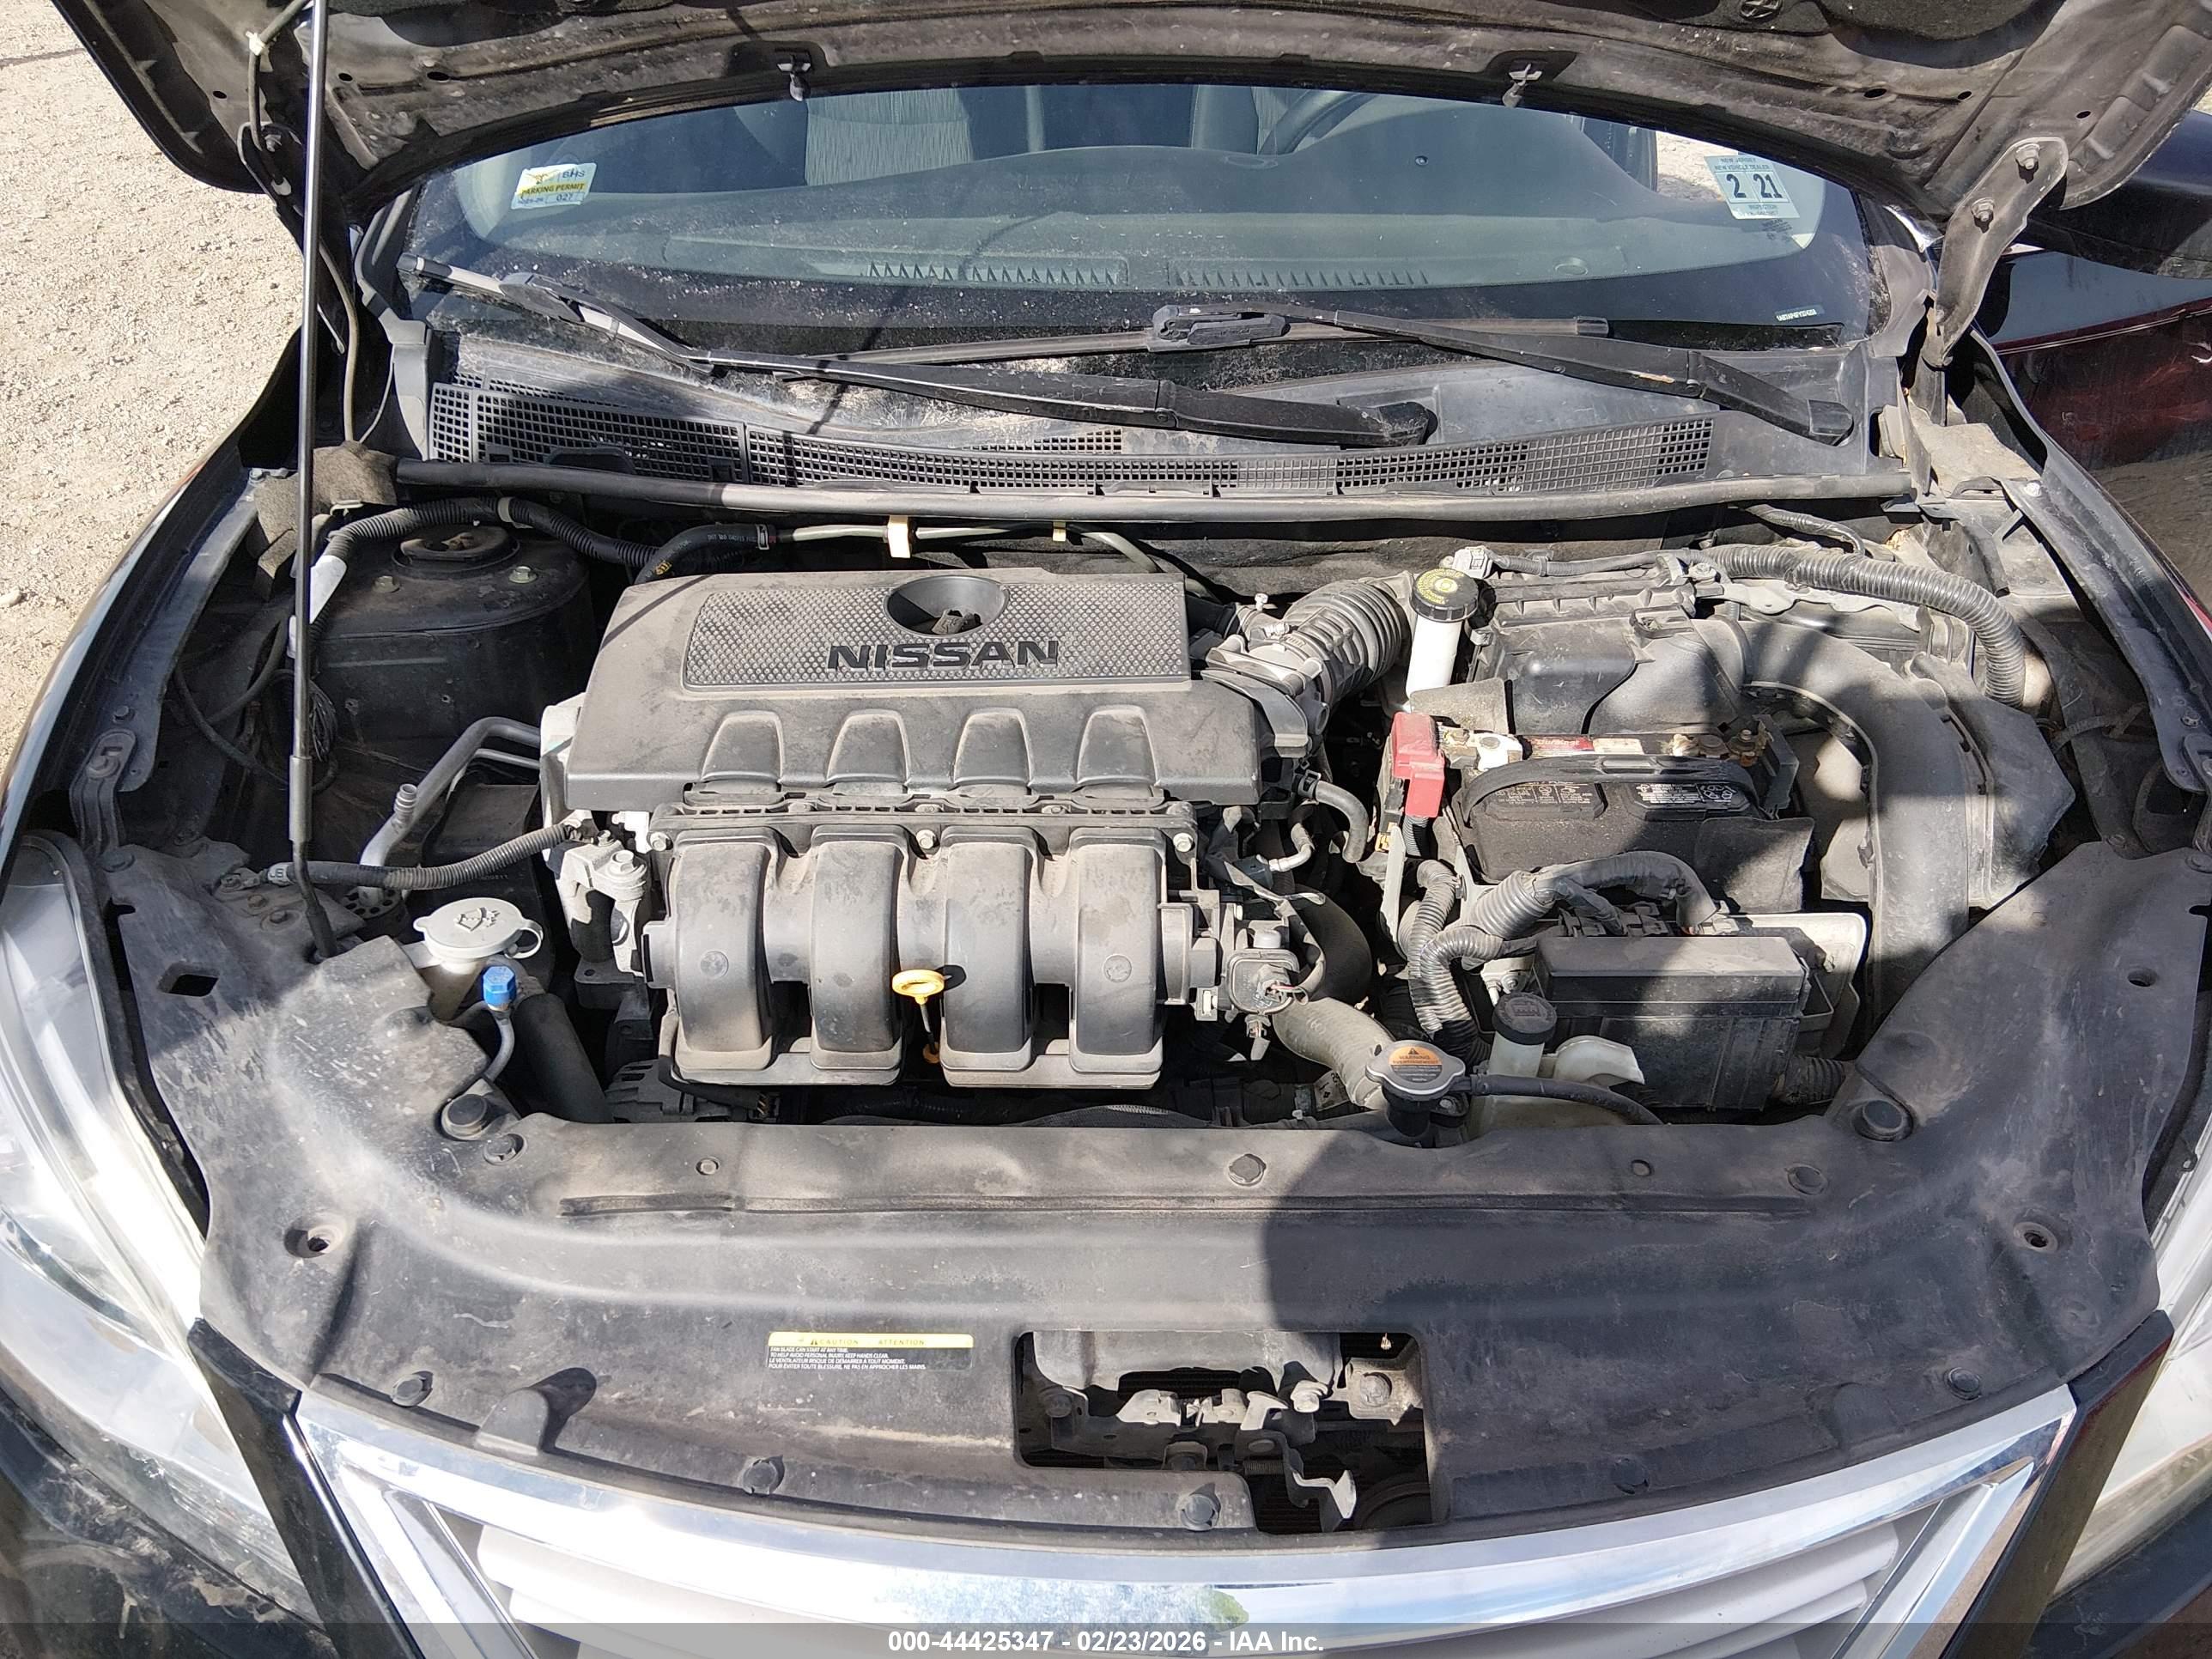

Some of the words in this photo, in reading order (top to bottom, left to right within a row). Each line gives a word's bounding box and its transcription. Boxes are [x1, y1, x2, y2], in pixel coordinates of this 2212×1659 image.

[562, 168, 586, 178] BHS
[521, 185, 554, 196] PARKING
[555, 183, 586, 191] PERMIT
[1726, 173, 1747, 198] 2
[1753, 173, 1784, 198] 21
[556, 192, 574, 202] 027
[827, 640, 1059, 671] NISSAN
